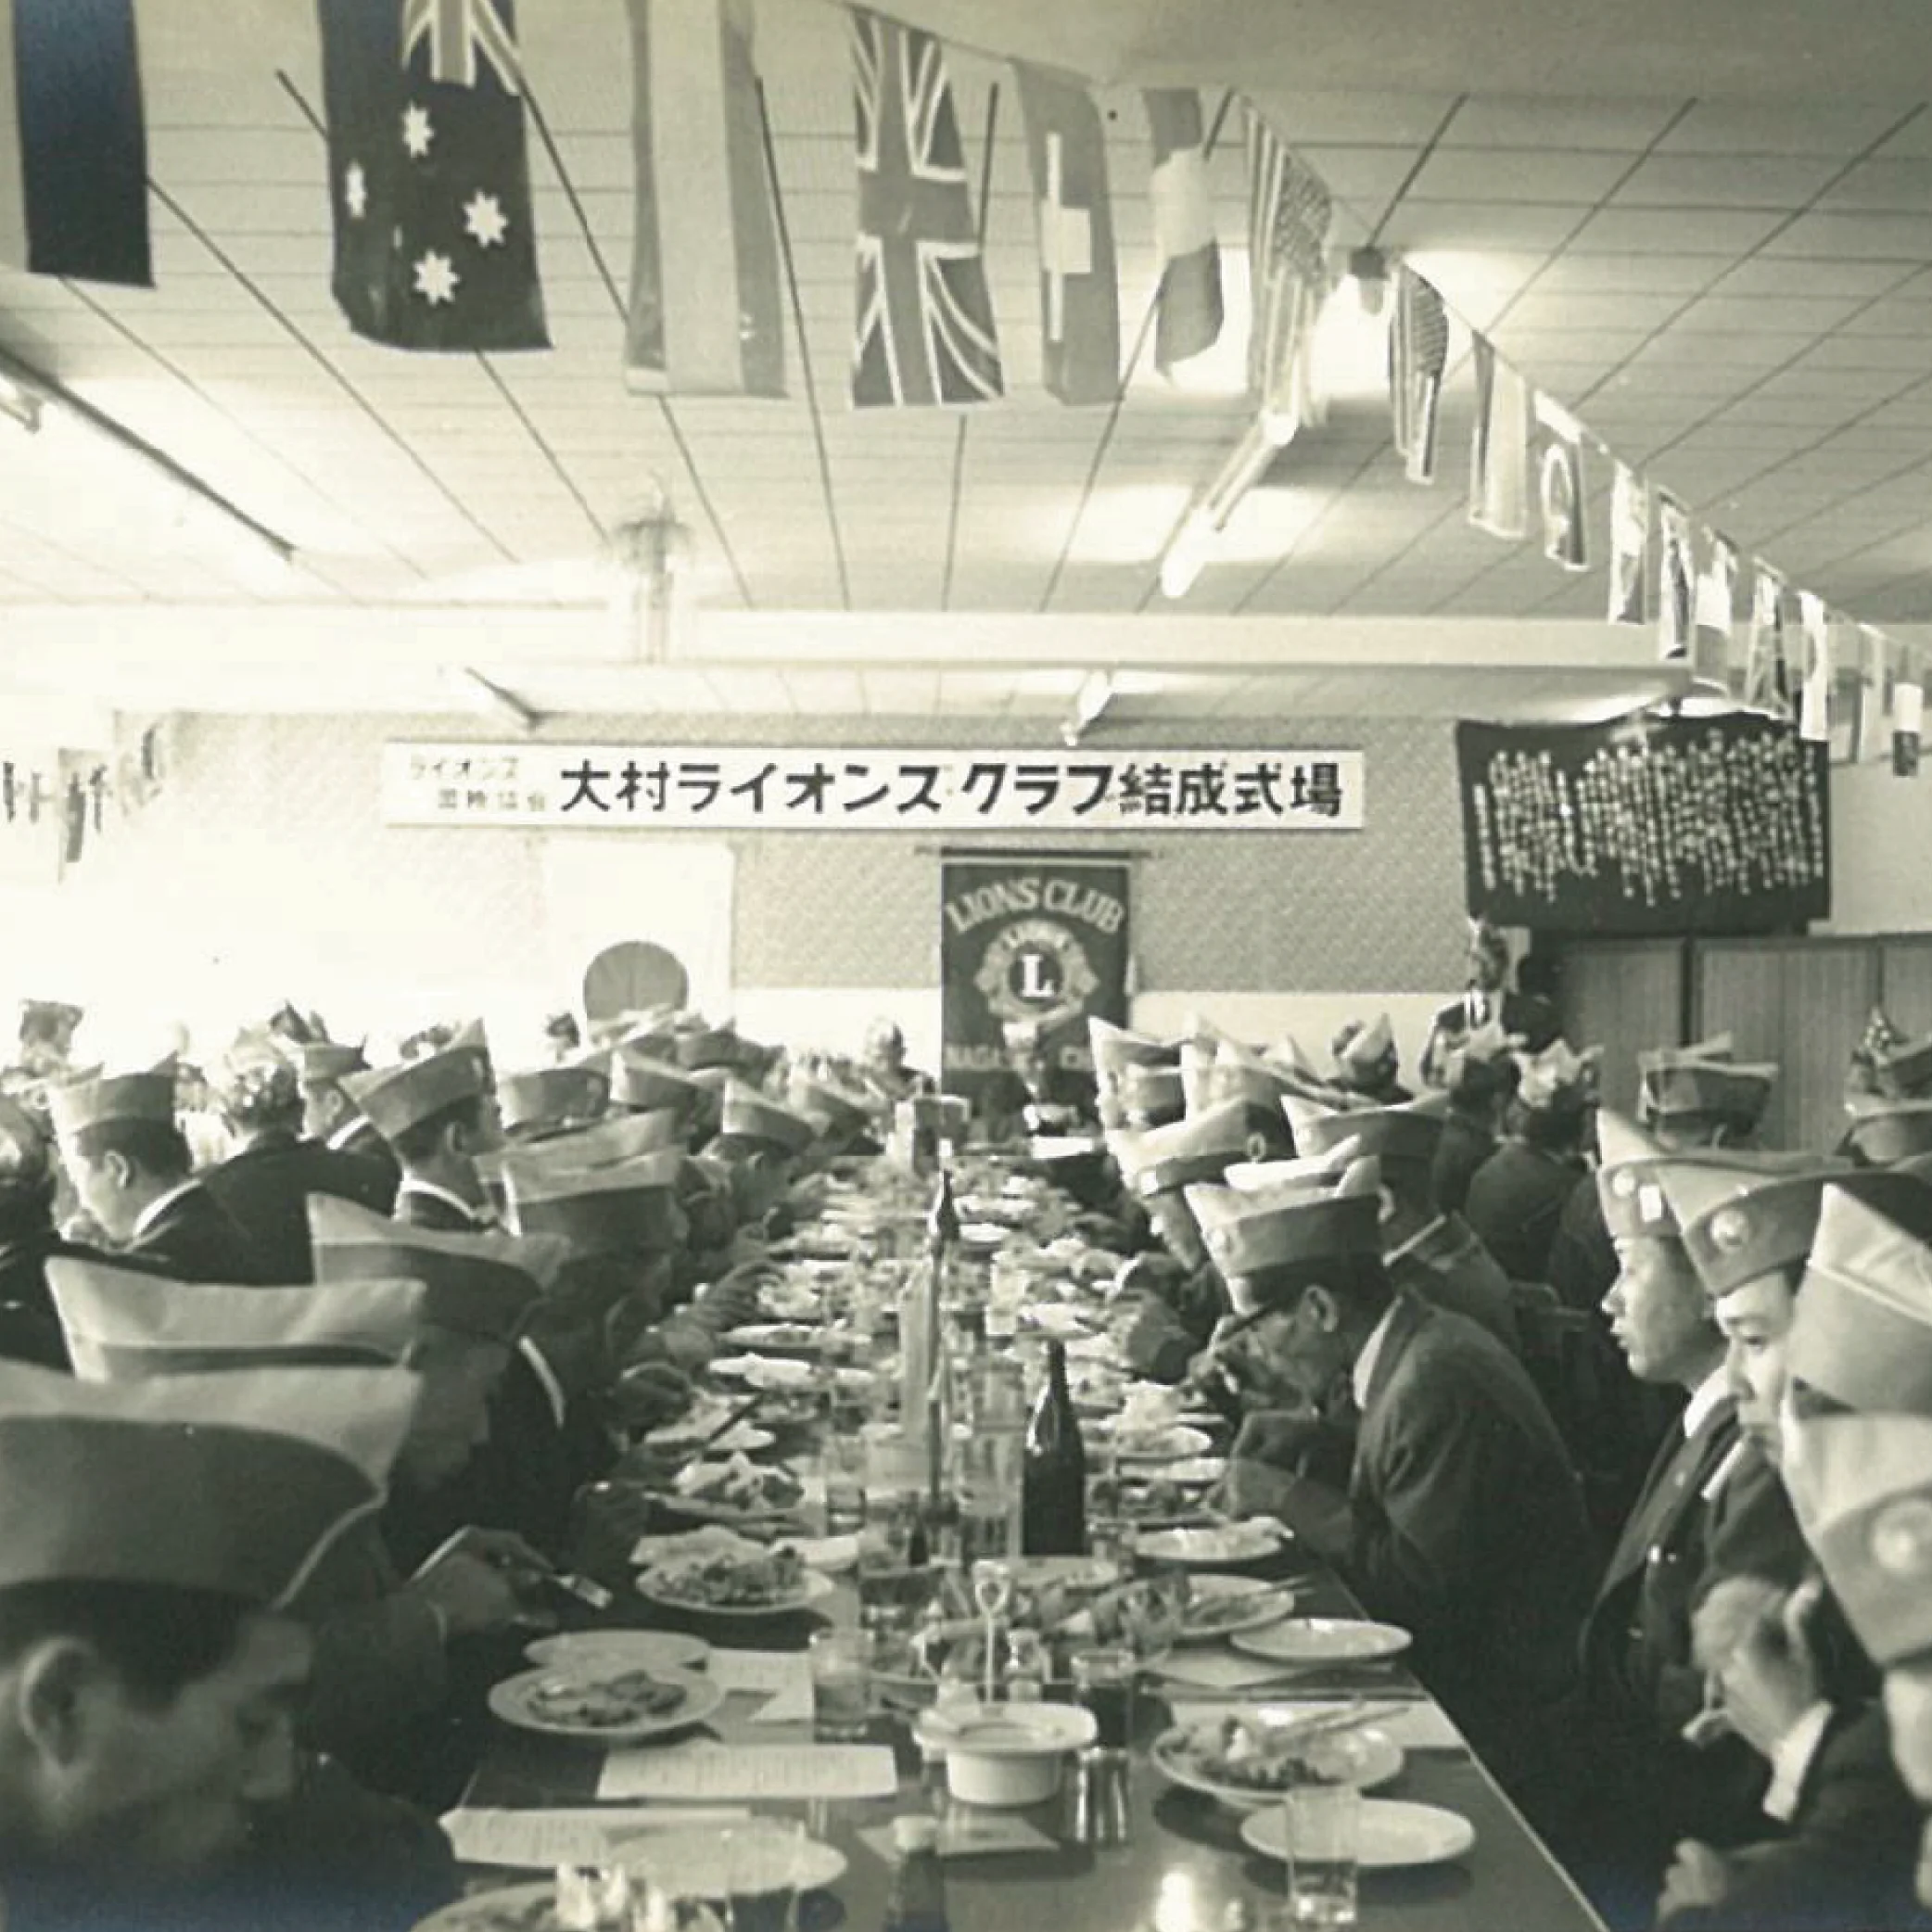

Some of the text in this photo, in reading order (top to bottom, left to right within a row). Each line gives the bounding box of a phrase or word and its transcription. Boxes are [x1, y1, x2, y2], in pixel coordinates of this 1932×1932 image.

[946, 878, 1040, 933] LIONS
[1043, 879, 1125, 934] CLUB
[1021, 953, 1055, 998] L
